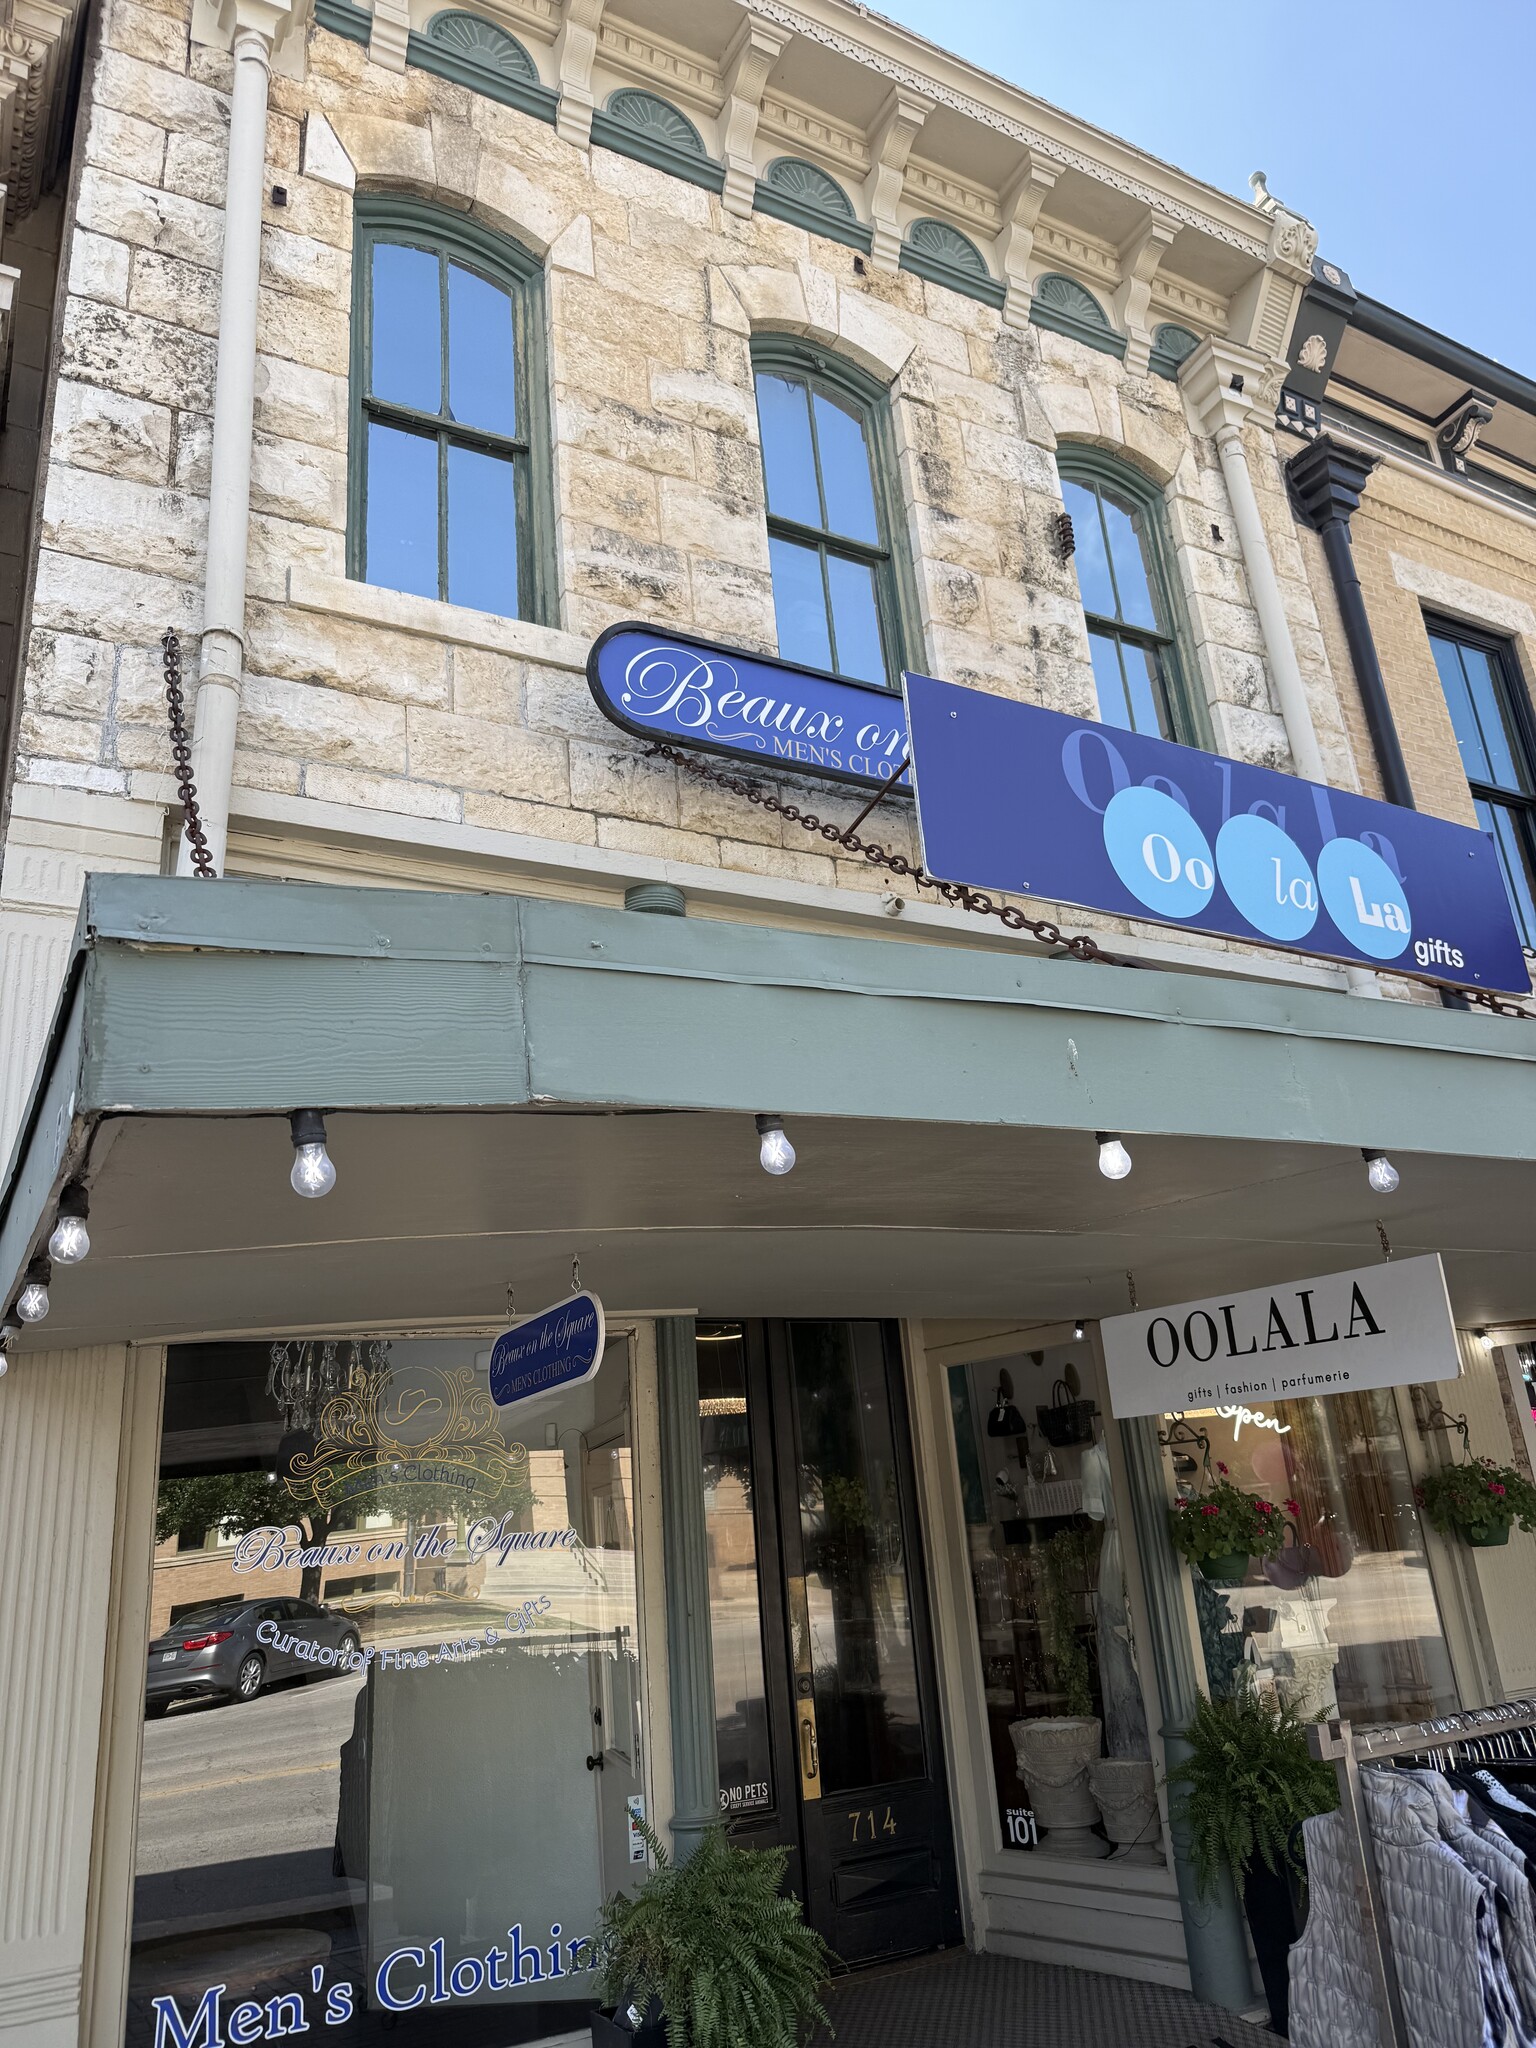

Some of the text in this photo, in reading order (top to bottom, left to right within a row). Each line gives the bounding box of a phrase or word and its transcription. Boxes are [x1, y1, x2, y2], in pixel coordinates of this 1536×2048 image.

[621, 647, 911, 761] Beaux on
[772, 736, 843, 769] MEN'S
[1142, 833, 1411, 934] Oo la La
[1413, 937, 1465, 968] gifts
[1146, 1281, 1386, 1368] OOLALA
[492, 1309, 595, 1378] Beaux on the Square
[532, 1356, 572, 1386] CLOTHING
[1187, 1385, 1213, 1402] gifts
[1225, 1379, 1268, 1395] fashion
[1281, 1370, 1350, 1390] parfumerie
[403, 1464, 477, 1494] Clothing
[231, 1510, 577, 1574] Beaux on the Square
[256, 1593, 552, 1677] Curator of Fine Arts & Gifts
[729, 1782, 768, 1802] NO PETS
[848, 1806, 897, 1842] 714
[1006, 1807, 1035, 1818] suite
[1007, 1815, 1039, 1845] 101
[151, 1922, 608, 2048] Men's Clothin
